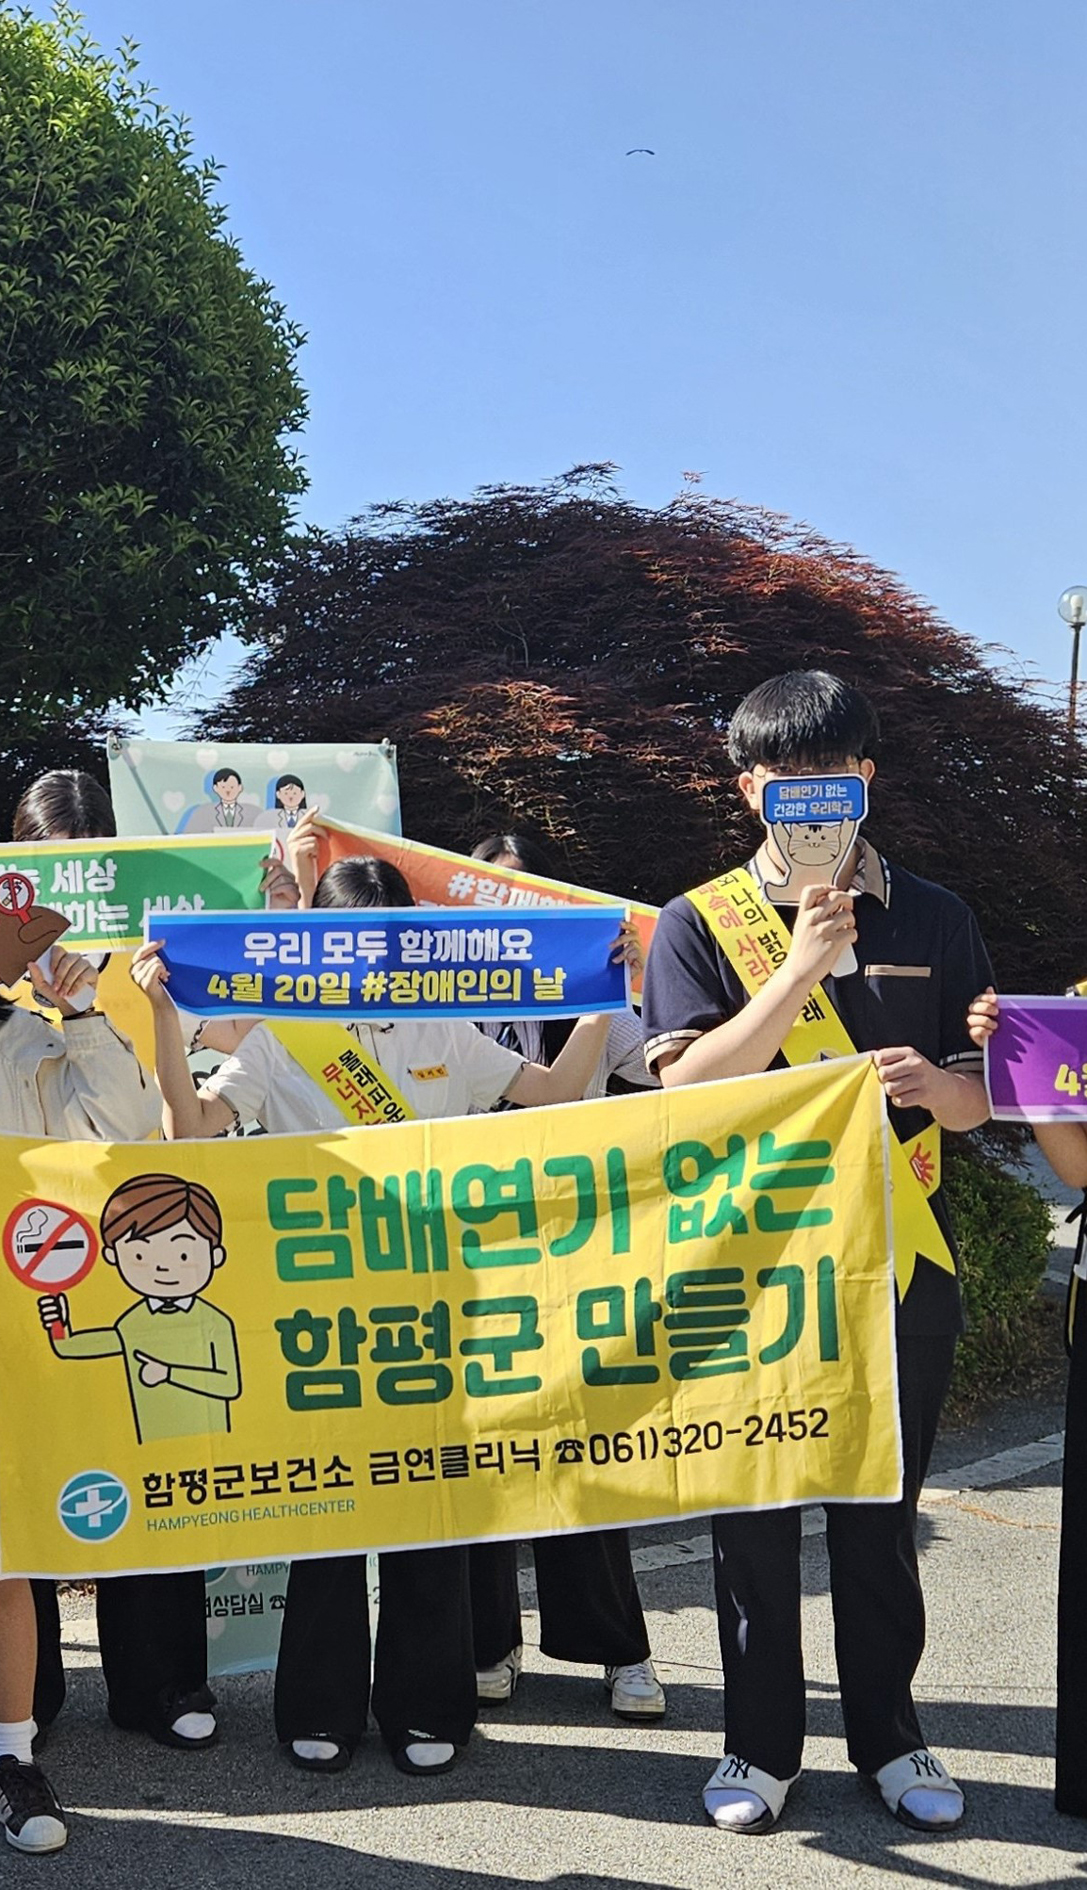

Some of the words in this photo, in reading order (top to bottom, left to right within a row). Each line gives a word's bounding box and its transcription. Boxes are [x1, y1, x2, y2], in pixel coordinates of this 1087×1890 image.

[774, 802, 807, 817] 건강한
[810, 800, 853, 815] 우리학교
[825, 784, 848, 798] 없는
[51, 858, 117, 894] 세상
[731, 887, 768, 926] 나의
[243, 931, 311, 966] 우리
[321, 930, 388, 965] 모두
[398, 928, 533, 964] 함께해요
[736, 933, 771, 987] 사라
[207, 974, 263, 1004] 4월
[274, 971, 351, 1003] 20일
[361, 968, 522, 1003] #장애인의
[532, 966, 566, 1001] 날
[1054, 1063, 1087, 1099] 4
[266, 1145, 631, 1284] 담배연기
[662, 1129, 834, 1245] 없는
[274, 1295, 546, 1413] 함평군
[575, 1254, 841, 1388] 만들기
[142, 1454, 355, 1509] 함평군보건소
[368, 1437, 541, 1486] 금연클리닉
[589, 1406, 830, 1466] 061)320-2452
[146, 1509, 241, 1533] HAMPYEONG
[242, 1498, 356, 1523] HEALTHCENTER
